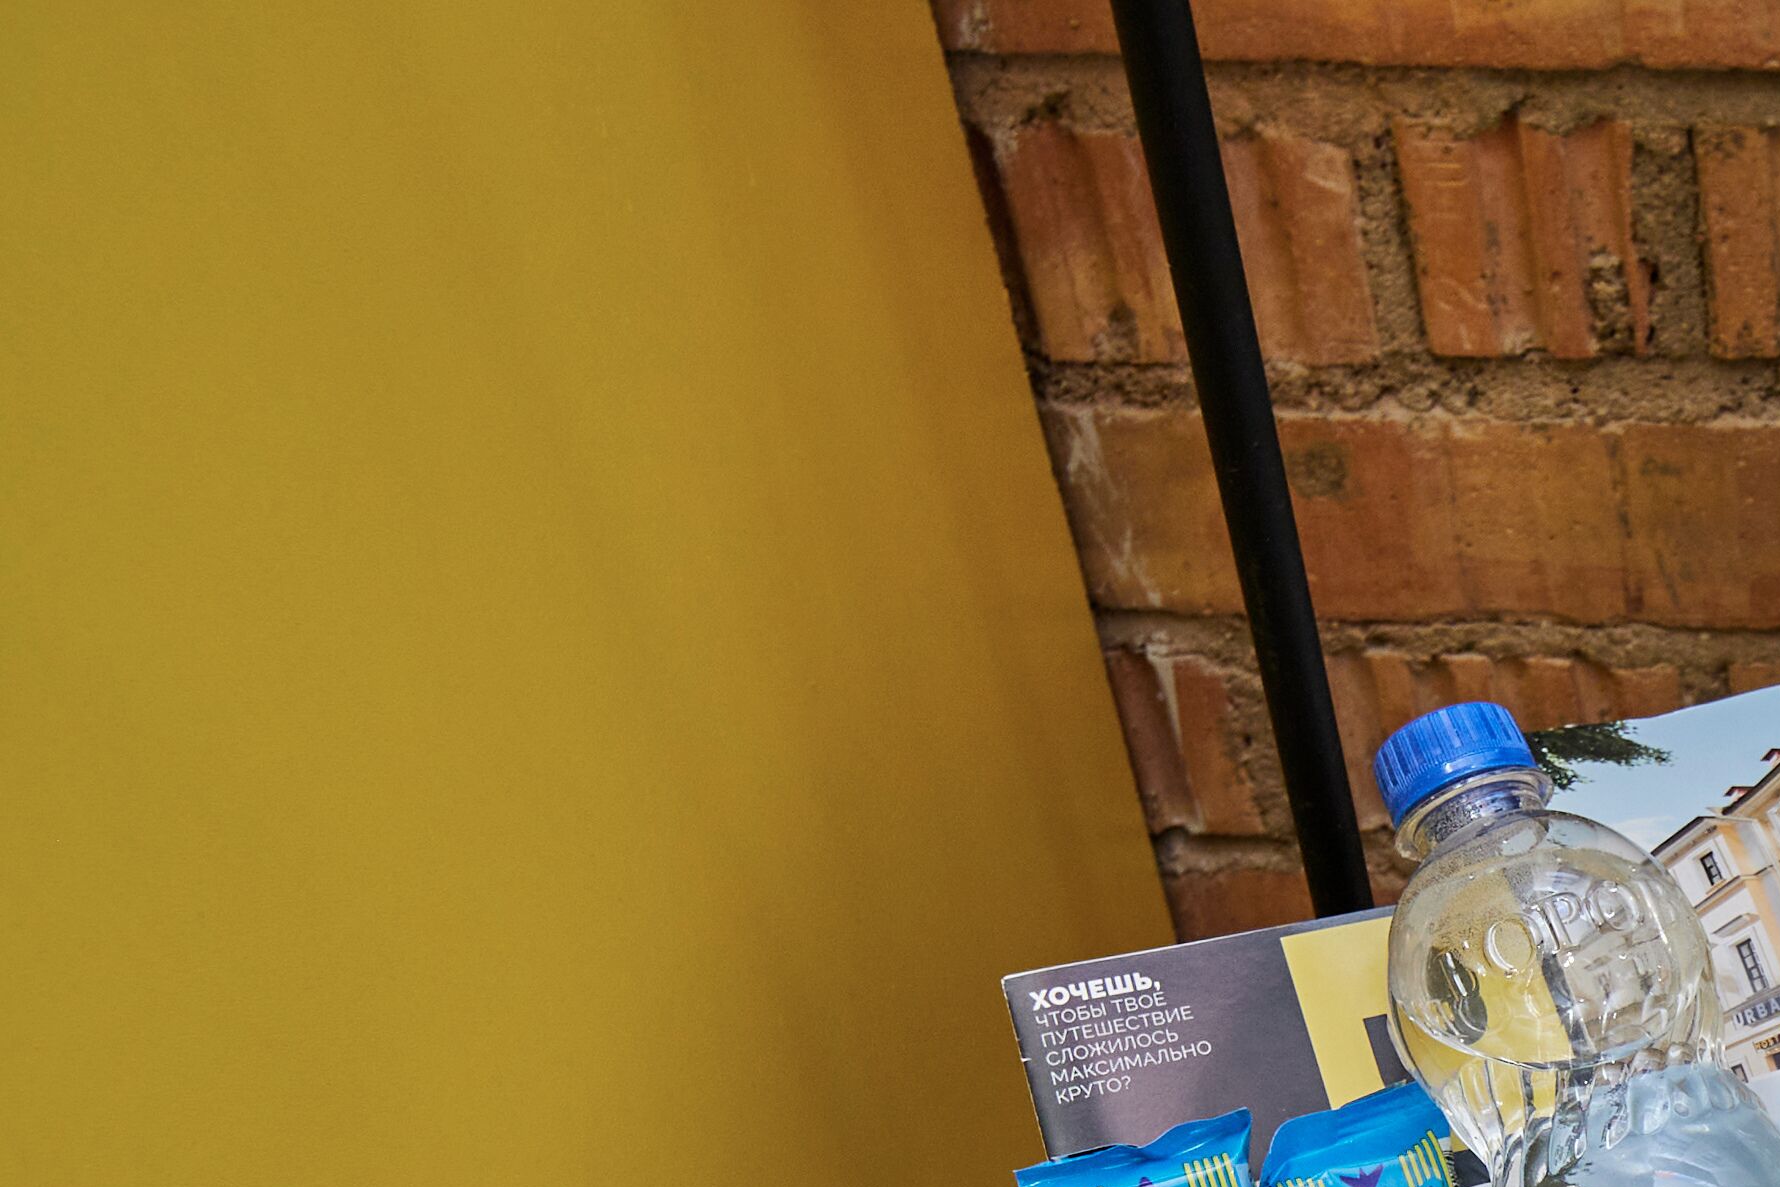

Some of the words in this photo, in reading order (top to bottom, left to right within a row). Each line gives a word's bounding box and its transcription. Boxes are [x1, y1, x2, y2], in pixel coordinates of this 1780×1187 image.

[1031, 973, 1161, 1011] ХОЧЕШЬ,
[1036, 1004, 1107, 1028] ЧТОБЫ
[1041, 1005, 1194, 1048] ПУТЕШЕСТВИЕ
[1045, 1029, 1179, 1067] СЛОЖИЛОСЬ
[1050, 1040, 1213, 1086] МАКСИМАЛЬНО
[1055, 1075, 1132, 1104] КРУТО?
